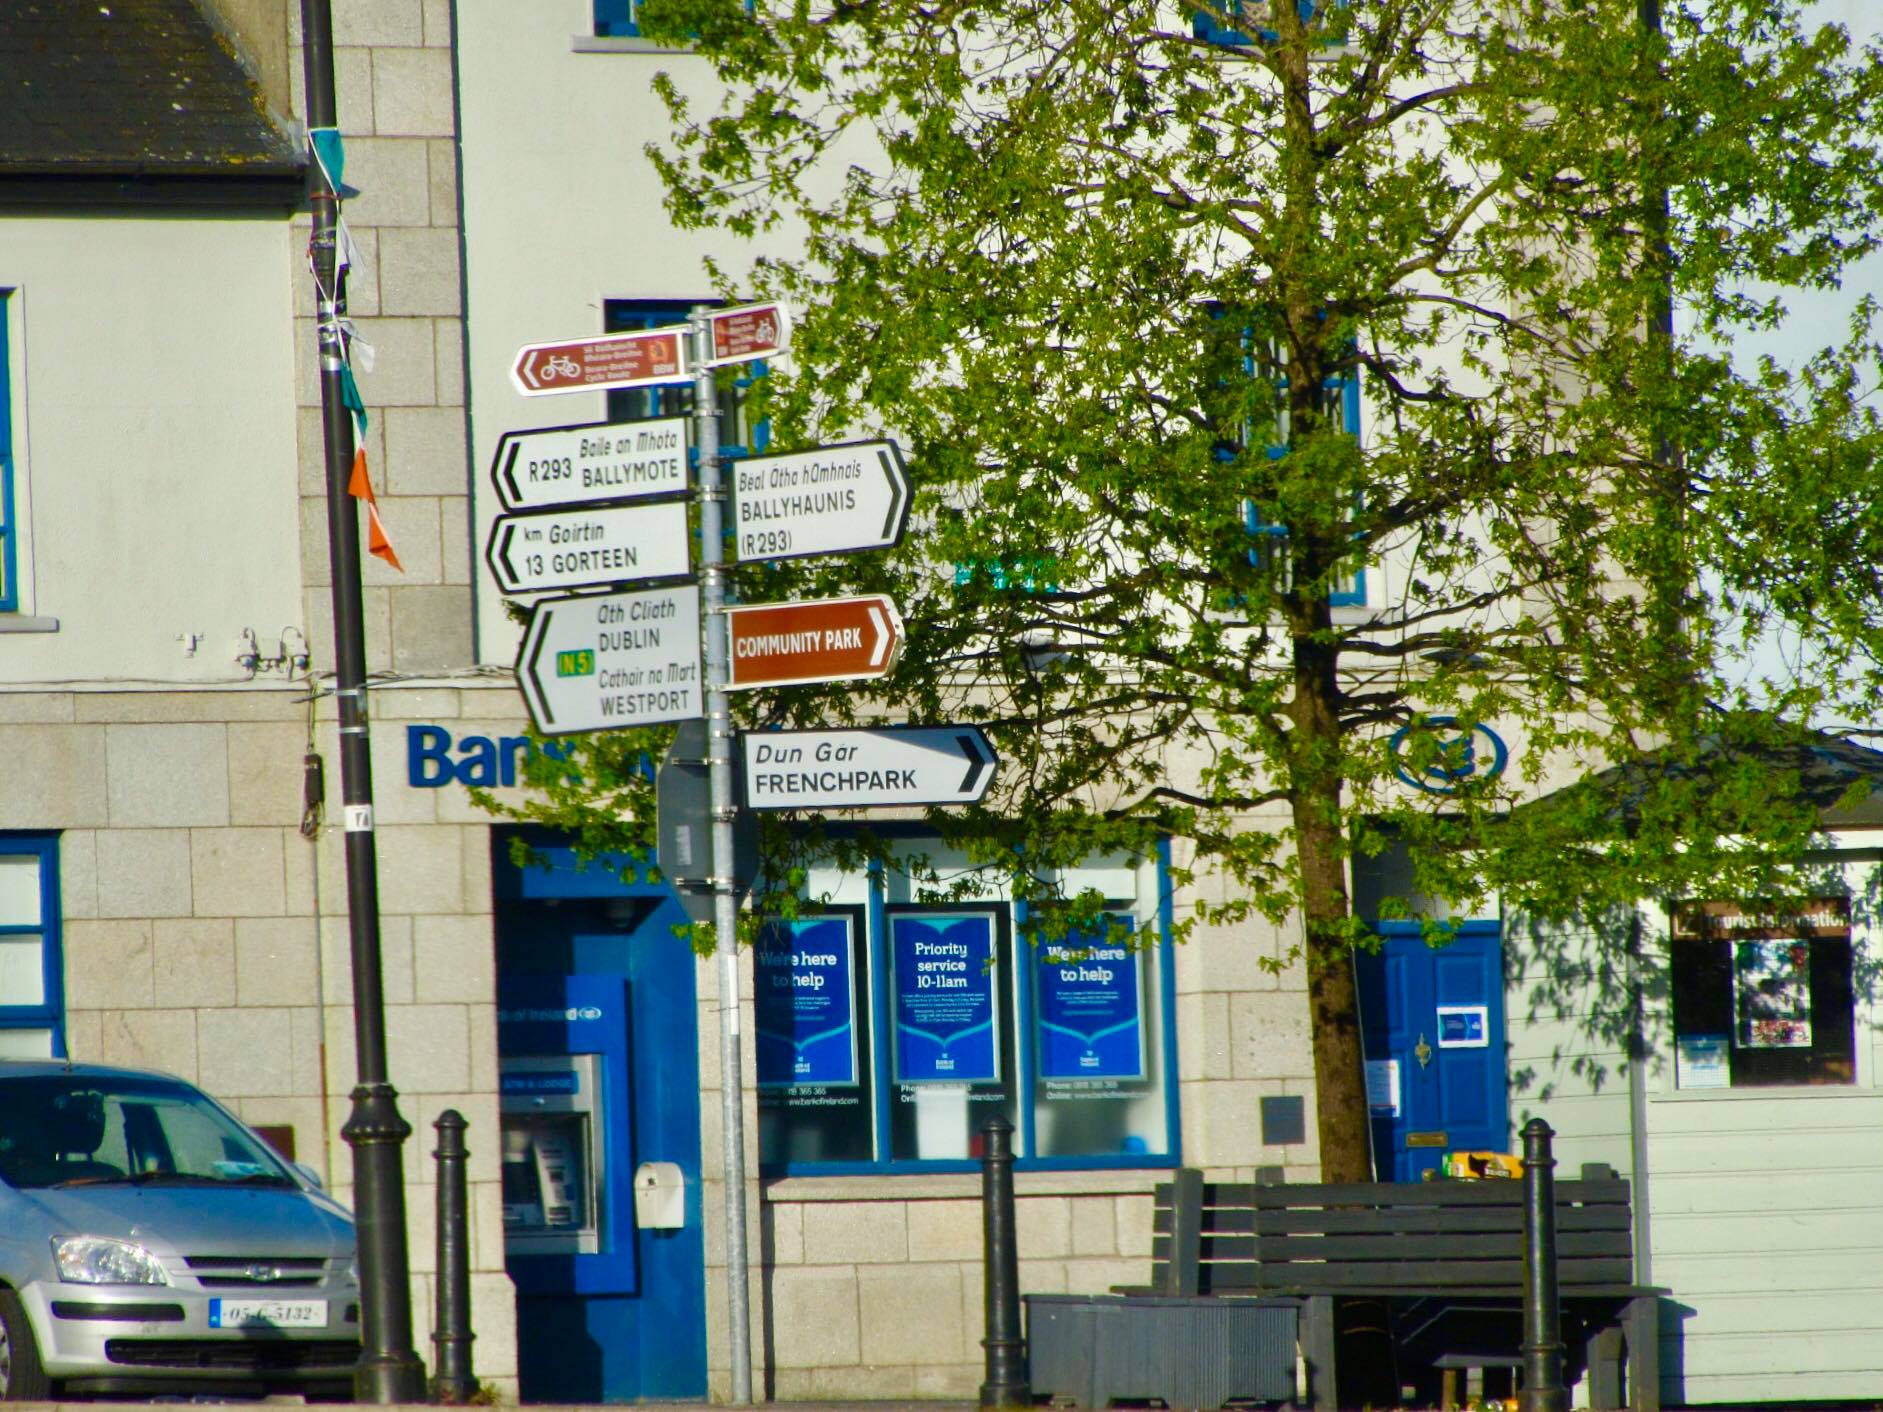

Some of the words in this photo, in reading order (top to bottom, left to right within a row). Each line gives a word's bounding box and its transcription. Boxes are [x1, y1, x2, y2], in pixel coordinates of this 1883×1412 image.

[579, 438, 611, 458] Baile
[616, 439, 631, 455] an
[528, 457, 573, 483] R293
[582, 458, 680, 488] BALLYMOTE
[741, 488, 857, 522] BALLYHAUNIS
[524, 527, 542, 542] km
[525, 554, 544, 576] 13
[552, 546, 638, 574] GORTEEN
[630, 597, 677, 621] Cliath
[599, 627, 661, 653] DUBLIN
[736, 630, 821, 658] COMMUNITY
[825, 627, 863, 651] PARK
[599, 667, 644, 689] Cathair
[648, 669, 663, 682] na
[667, 661, 697, 683] Mart
[600, 689, 690, 716] WESTPORT
[755, 769, 918, 794] FRENCHPARK
[801, 950, 838, 966] here
[914, 942, 968, 958] Priority
[917, 959, 967, 972] service
[1060, 967, 1077, 982] to
[1078, 966, 1114, 986] help
[791, 971, 825, 990] help
[917, 975, 968, 989] 10-11am
